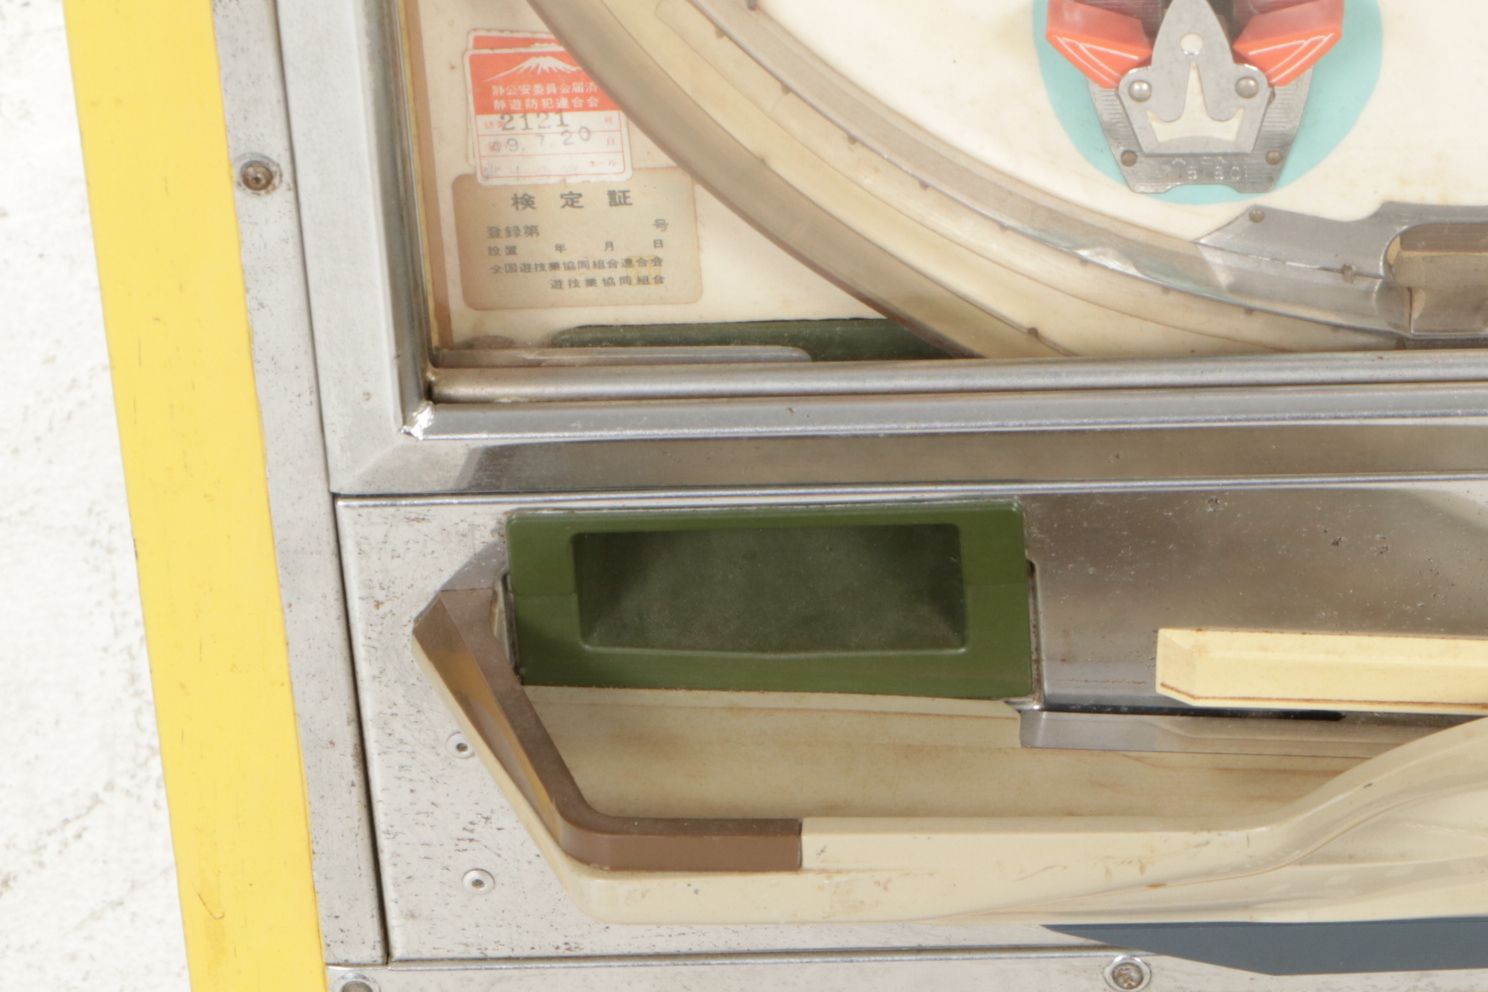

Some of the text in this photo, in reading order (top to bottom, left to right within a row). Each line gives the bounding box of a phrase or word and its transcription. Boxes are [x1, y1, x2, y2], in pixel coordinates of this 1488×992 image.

[499, 111, 569, 131] 2121
[511, 189, 633, 211] 検定証
[487, 218, 669, 239] 登録第 号
[488, 239, 664, 256] 設置 年 月 日
